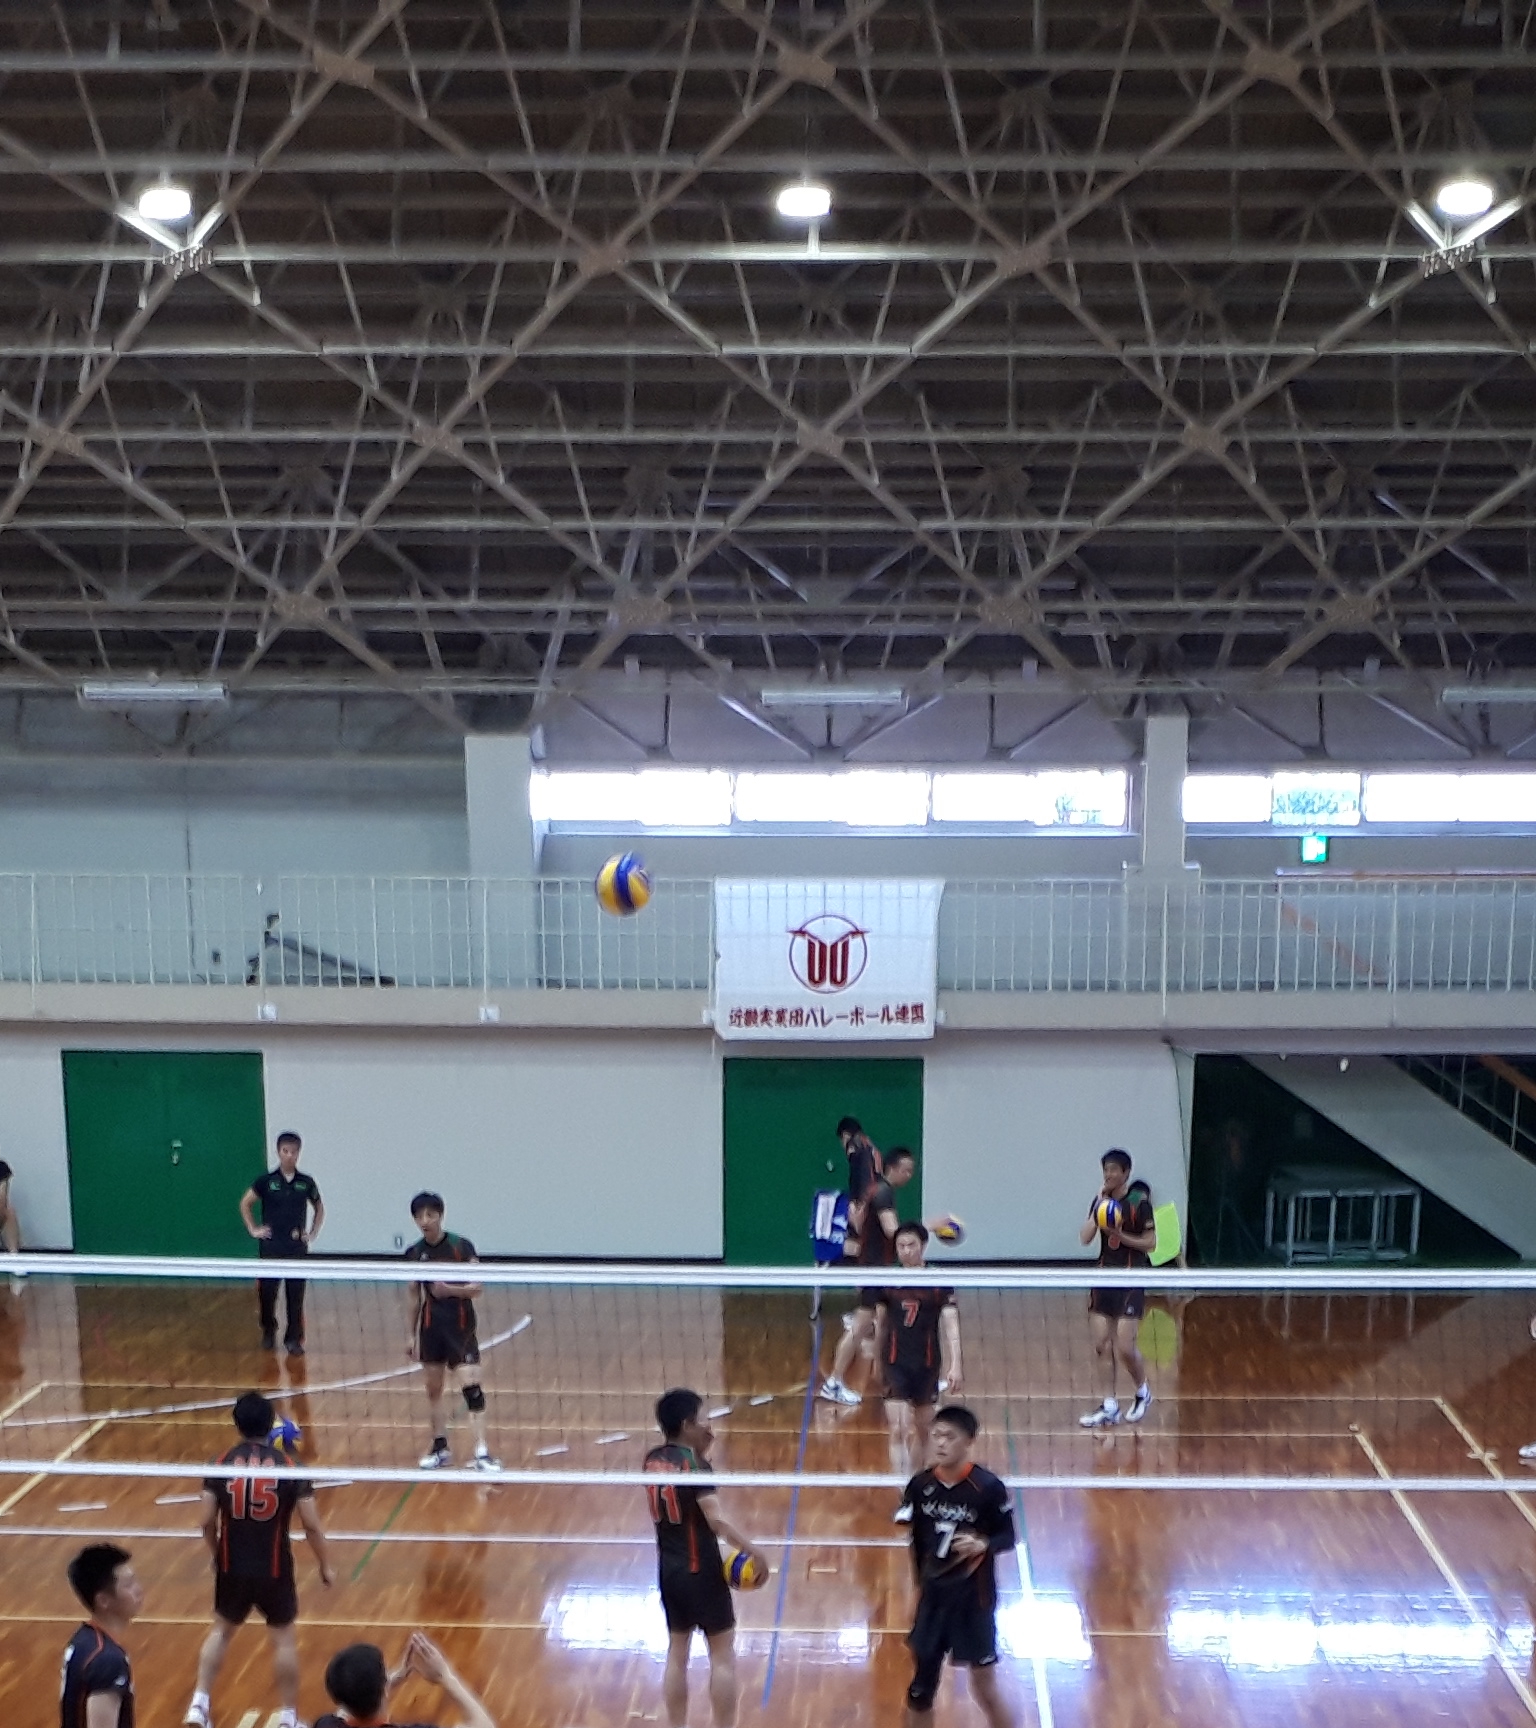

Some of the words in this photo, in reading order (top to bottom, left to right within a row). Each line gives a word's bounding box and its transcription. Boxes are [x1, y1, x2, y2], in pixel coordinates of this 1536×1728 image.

[901, 1299, 920, 1327] 7
[226, 1476, 279, 1522] 15
[934, 1521, 959, 1559] 7
